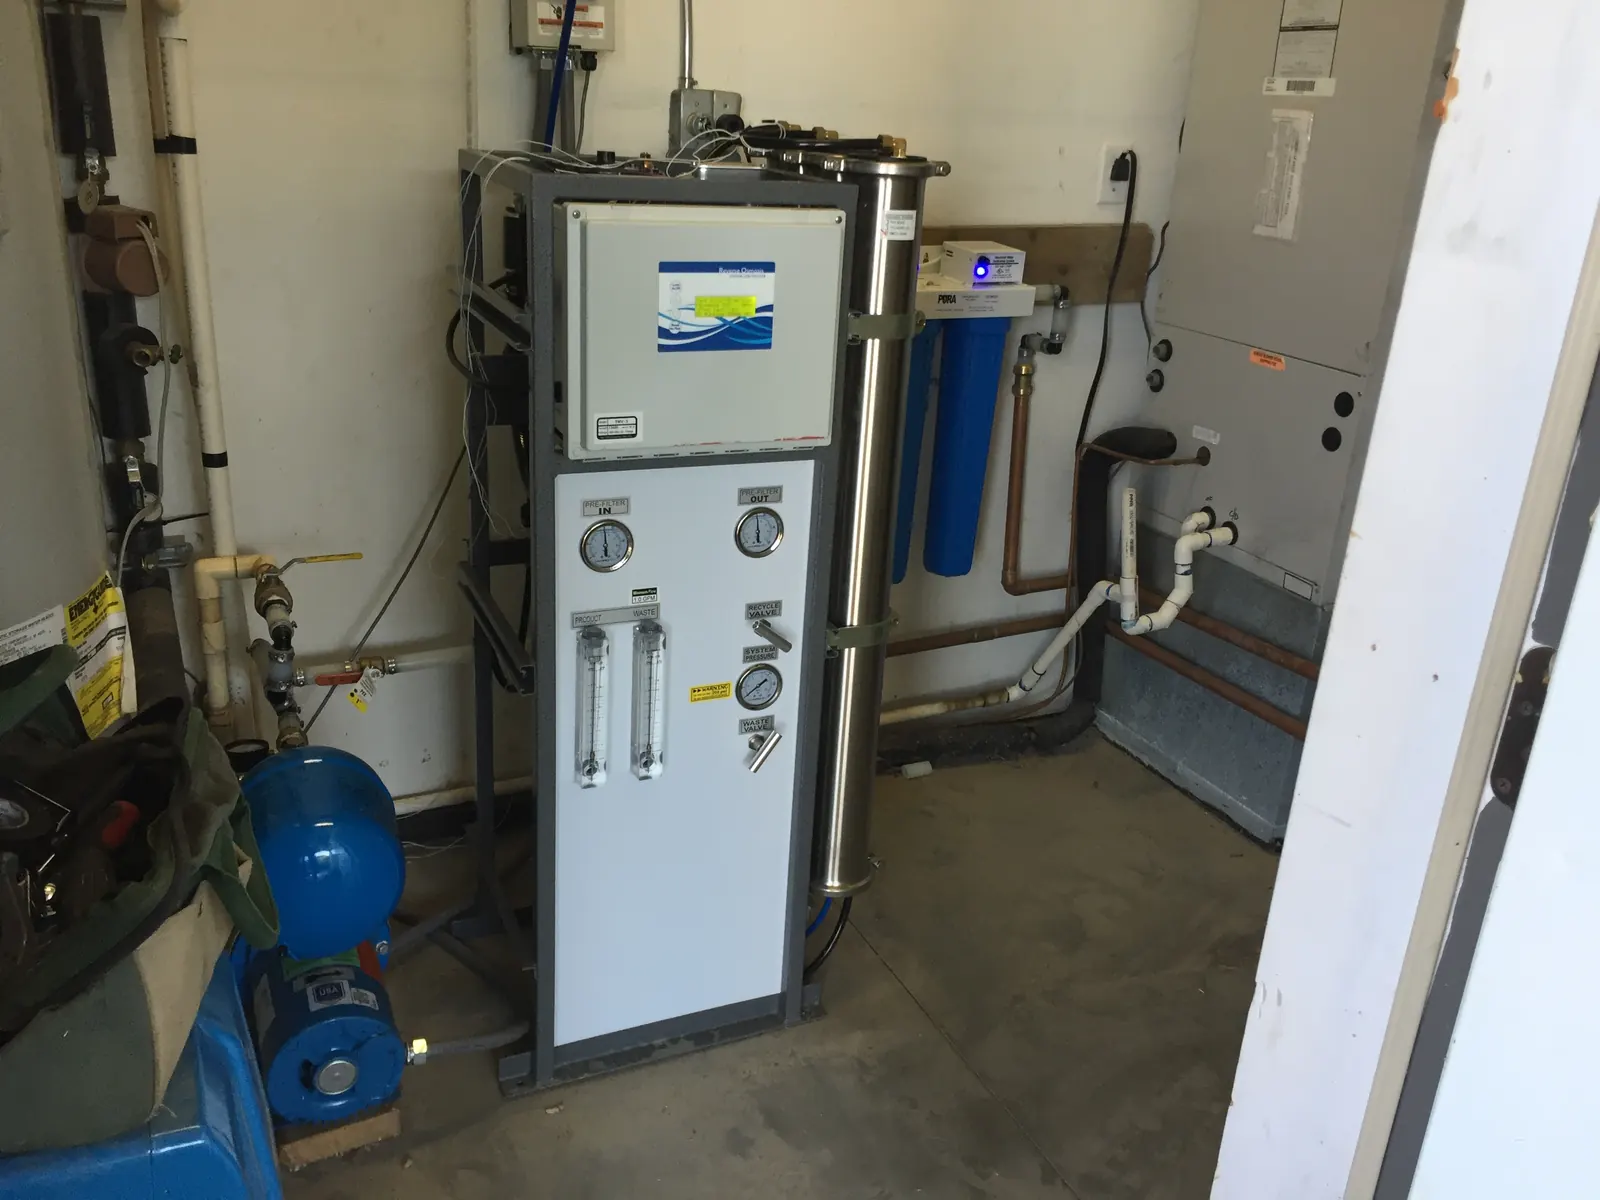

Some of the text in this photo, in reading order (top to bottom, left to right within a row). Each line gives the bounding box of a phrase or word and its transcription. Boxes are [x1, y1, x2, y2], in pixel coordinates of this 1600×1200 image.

[742, 487, 779, 496] PRE-FILTER
[585, 499, 626, 508] PRE-FILTER
[750, 495, 769, 503] OUT
[598, 507, 612, 515] IN
[748, 603, 779, 611] RECYCLE
[575, 608, 656, 624] PRODUCT WASTE
[749, 609, 777, 618] VALVE
[745, 646, 776, 655] SYSTEM
[745, 652, 776, 661] PRESSURE
[742, 717, 769, 727] WASTE
[743, 724, 768, 733] VALVE
[318, 984, 340, 997] USA
